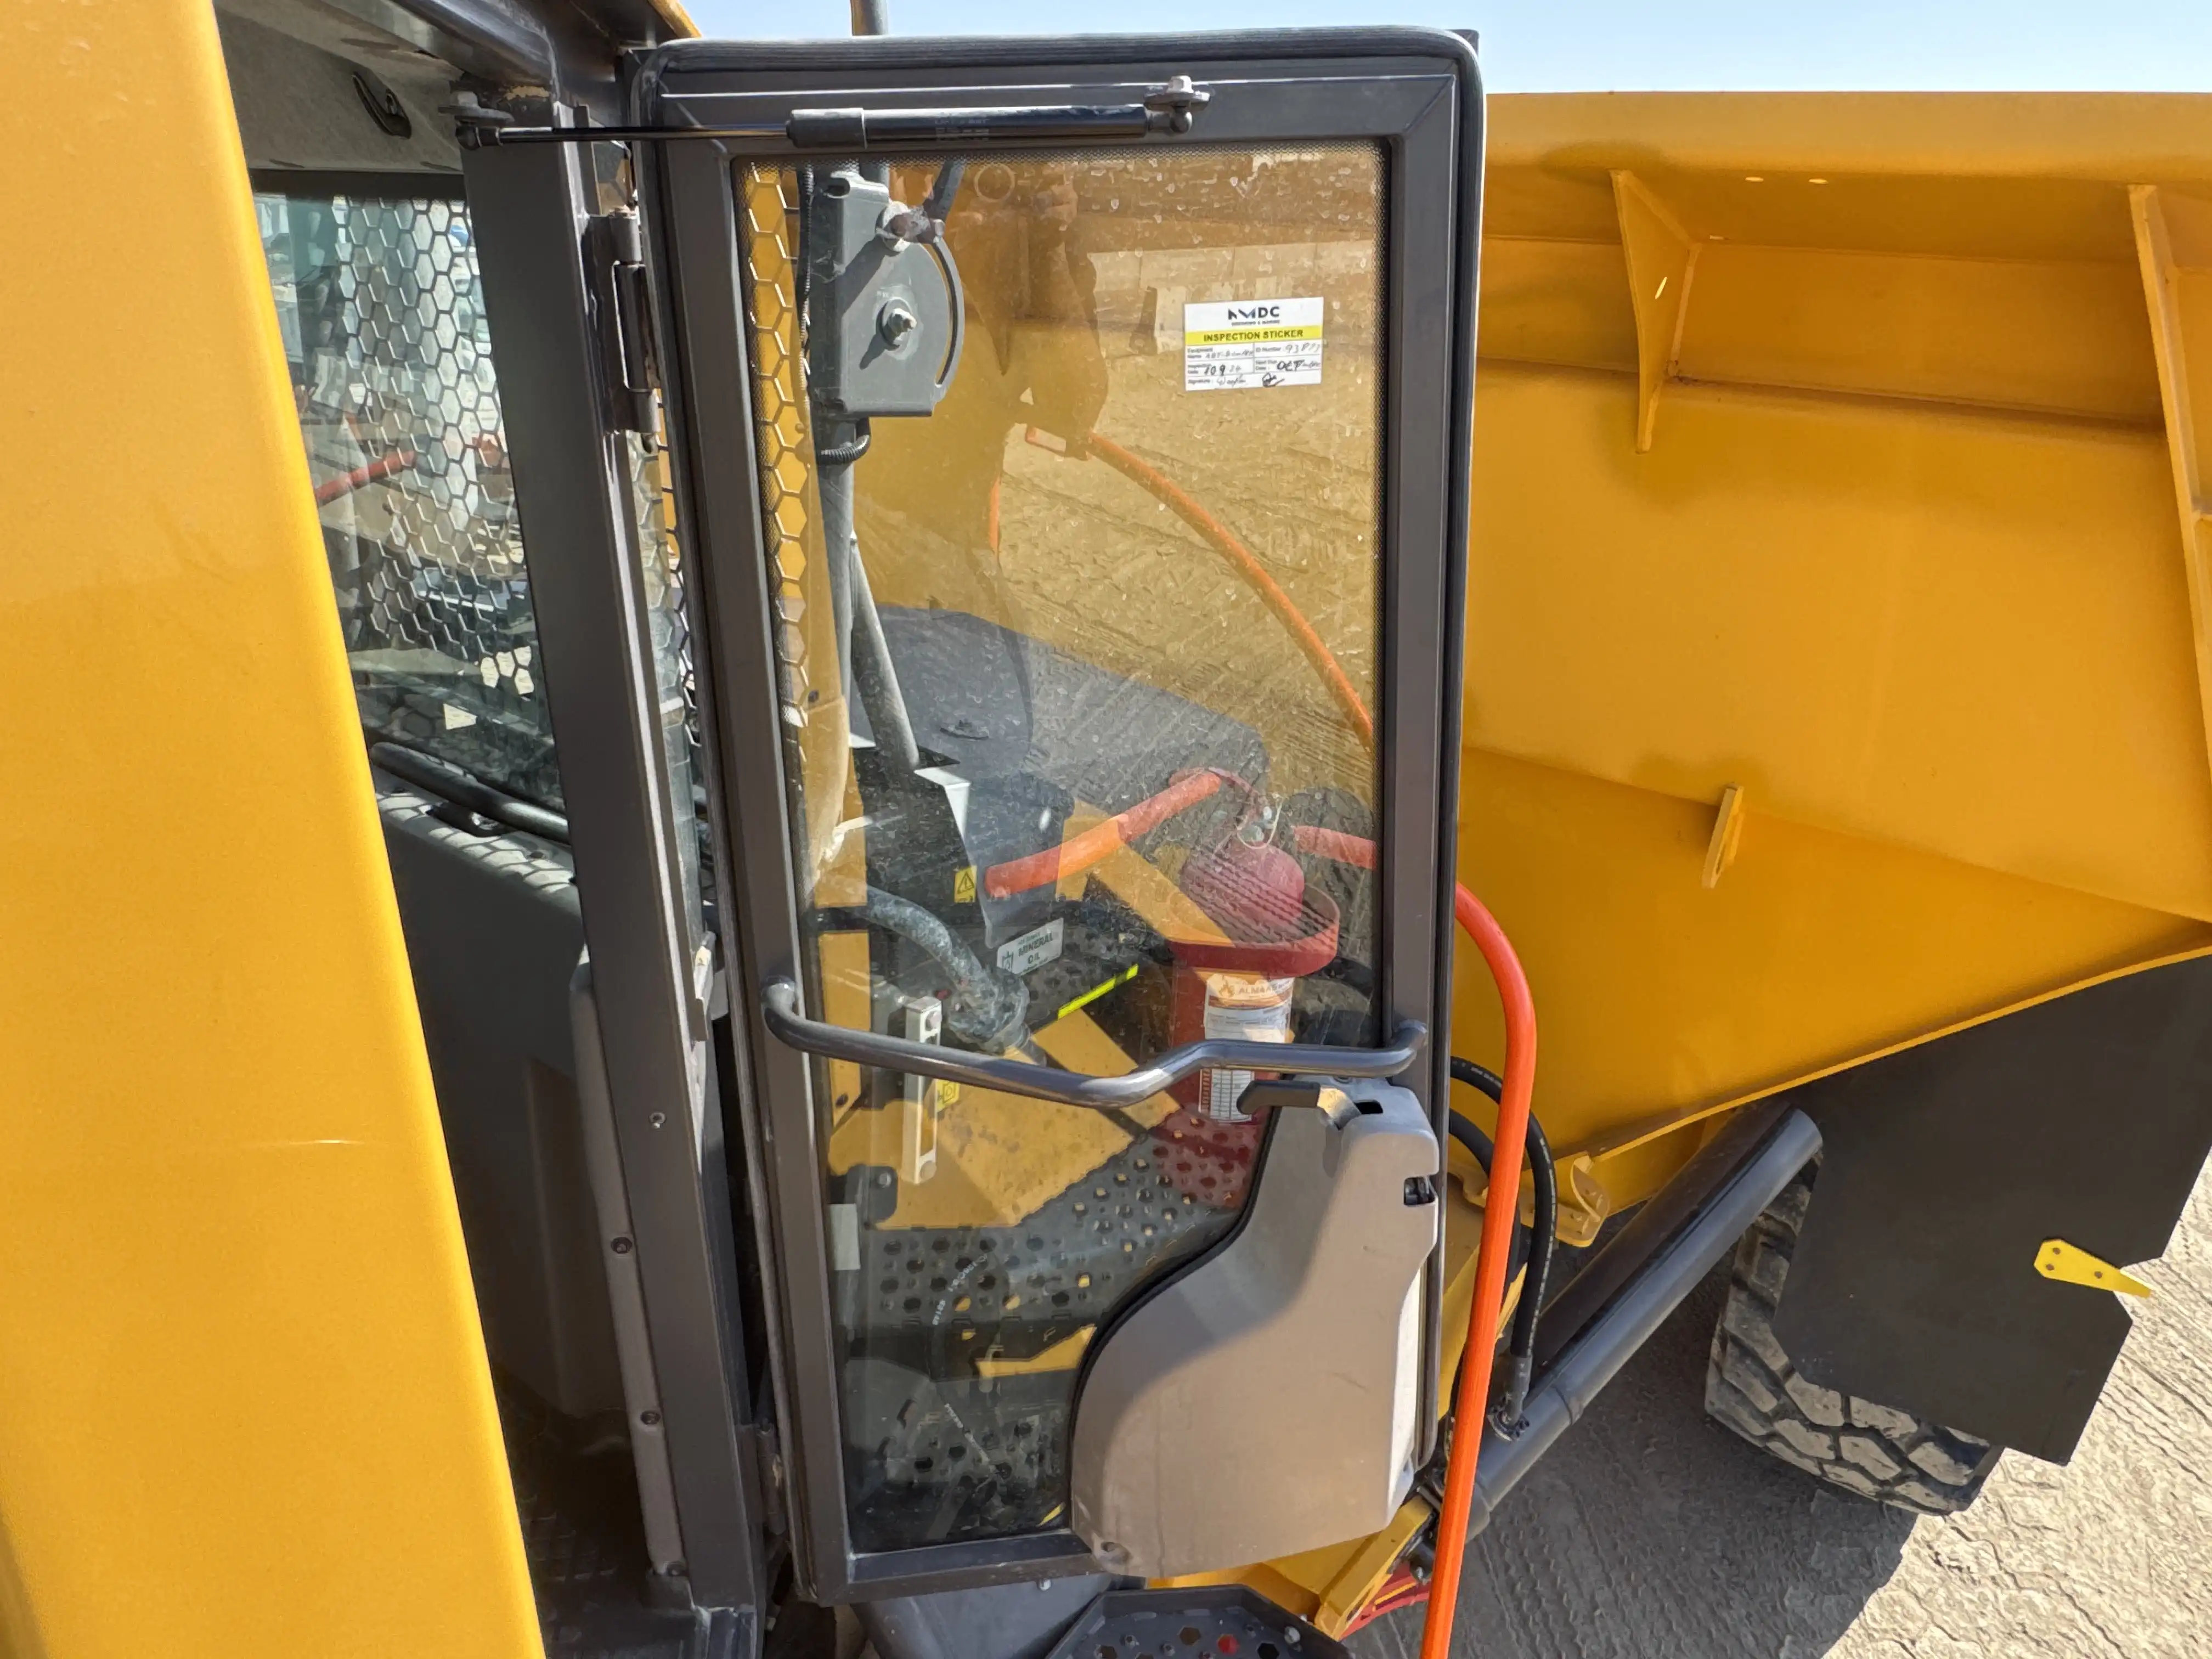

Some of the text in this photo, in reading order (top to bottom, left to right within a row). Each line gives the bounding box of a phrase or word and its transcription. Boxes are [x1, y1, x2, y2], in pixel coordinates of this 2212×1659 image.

[1204, 329, 1304, 342] INSPECTION STICKER
[1018, 933, 1053, 957] MINERAL
[1028, 952, 1040, 964] OIL
